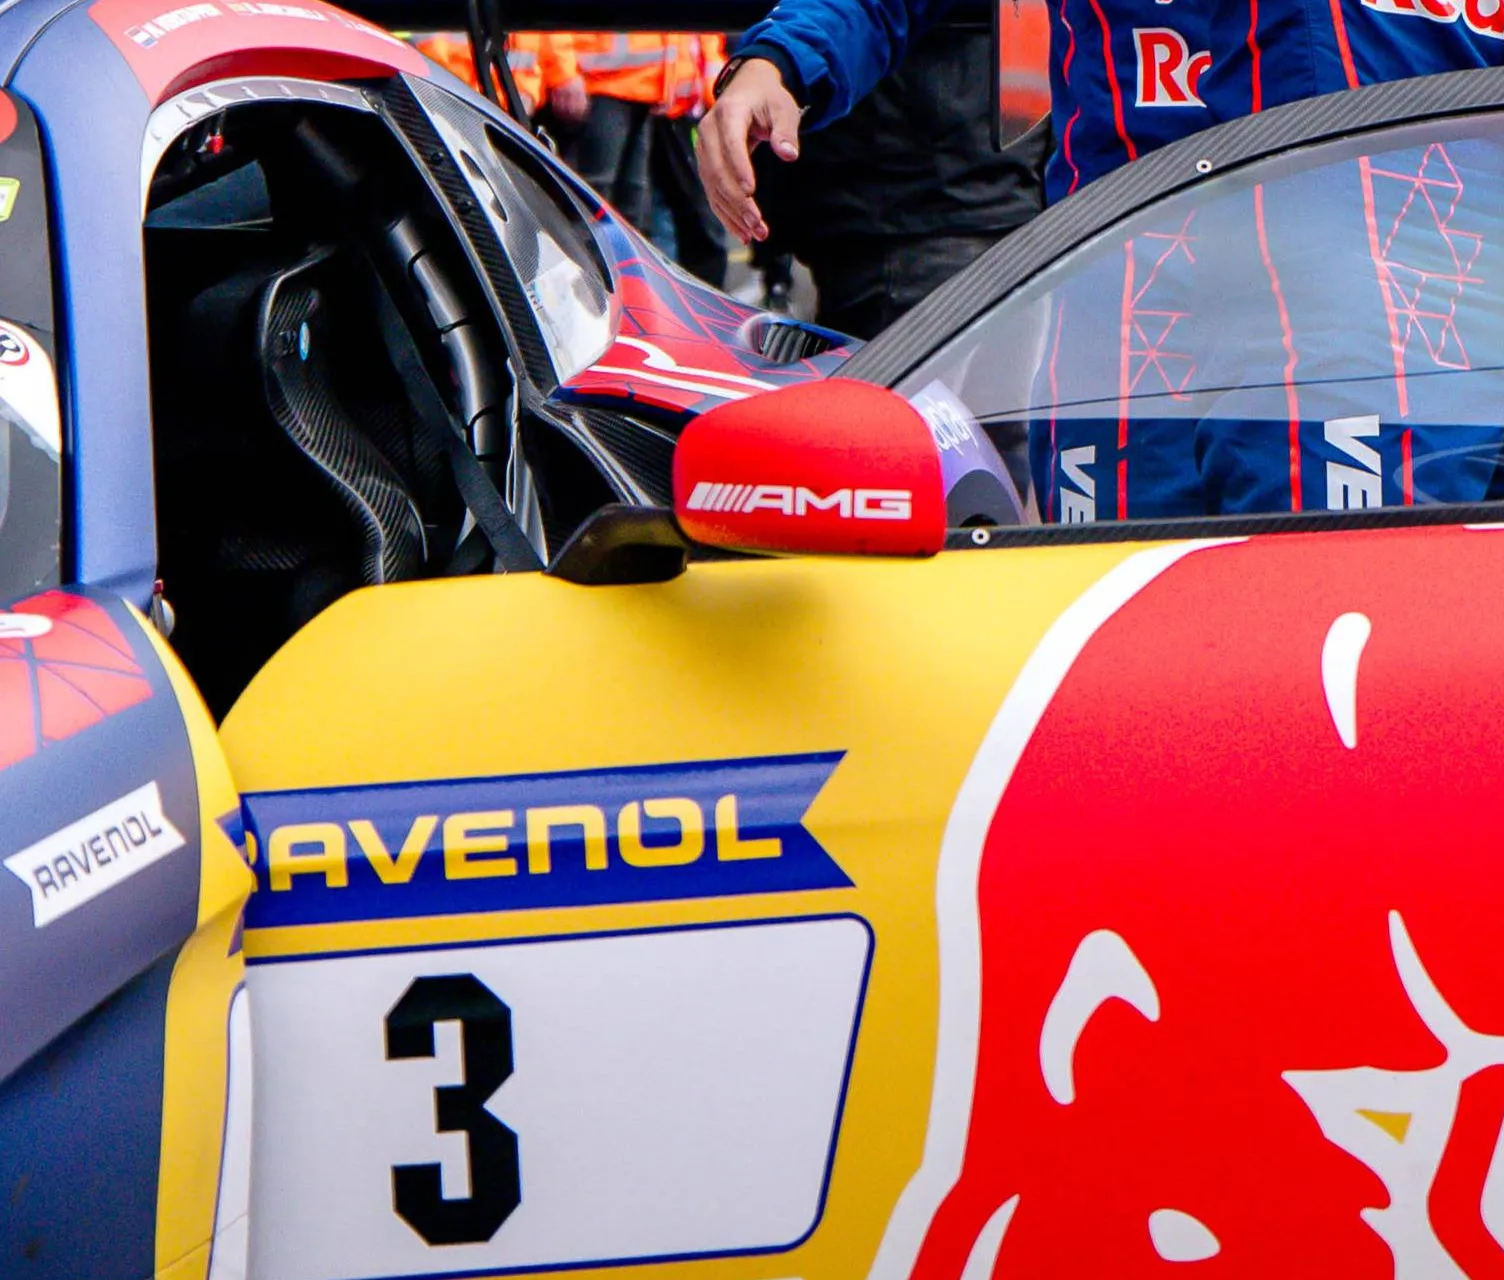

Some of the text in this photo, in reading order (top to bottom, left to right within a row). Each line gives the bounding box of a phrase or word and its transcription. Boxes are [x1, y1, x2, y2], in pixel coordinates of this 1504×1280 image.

[744, 485, 912, 520] AMG
[33, 811, 163, 898] RAVENOL
[383, 973, 522, 1247] 3
